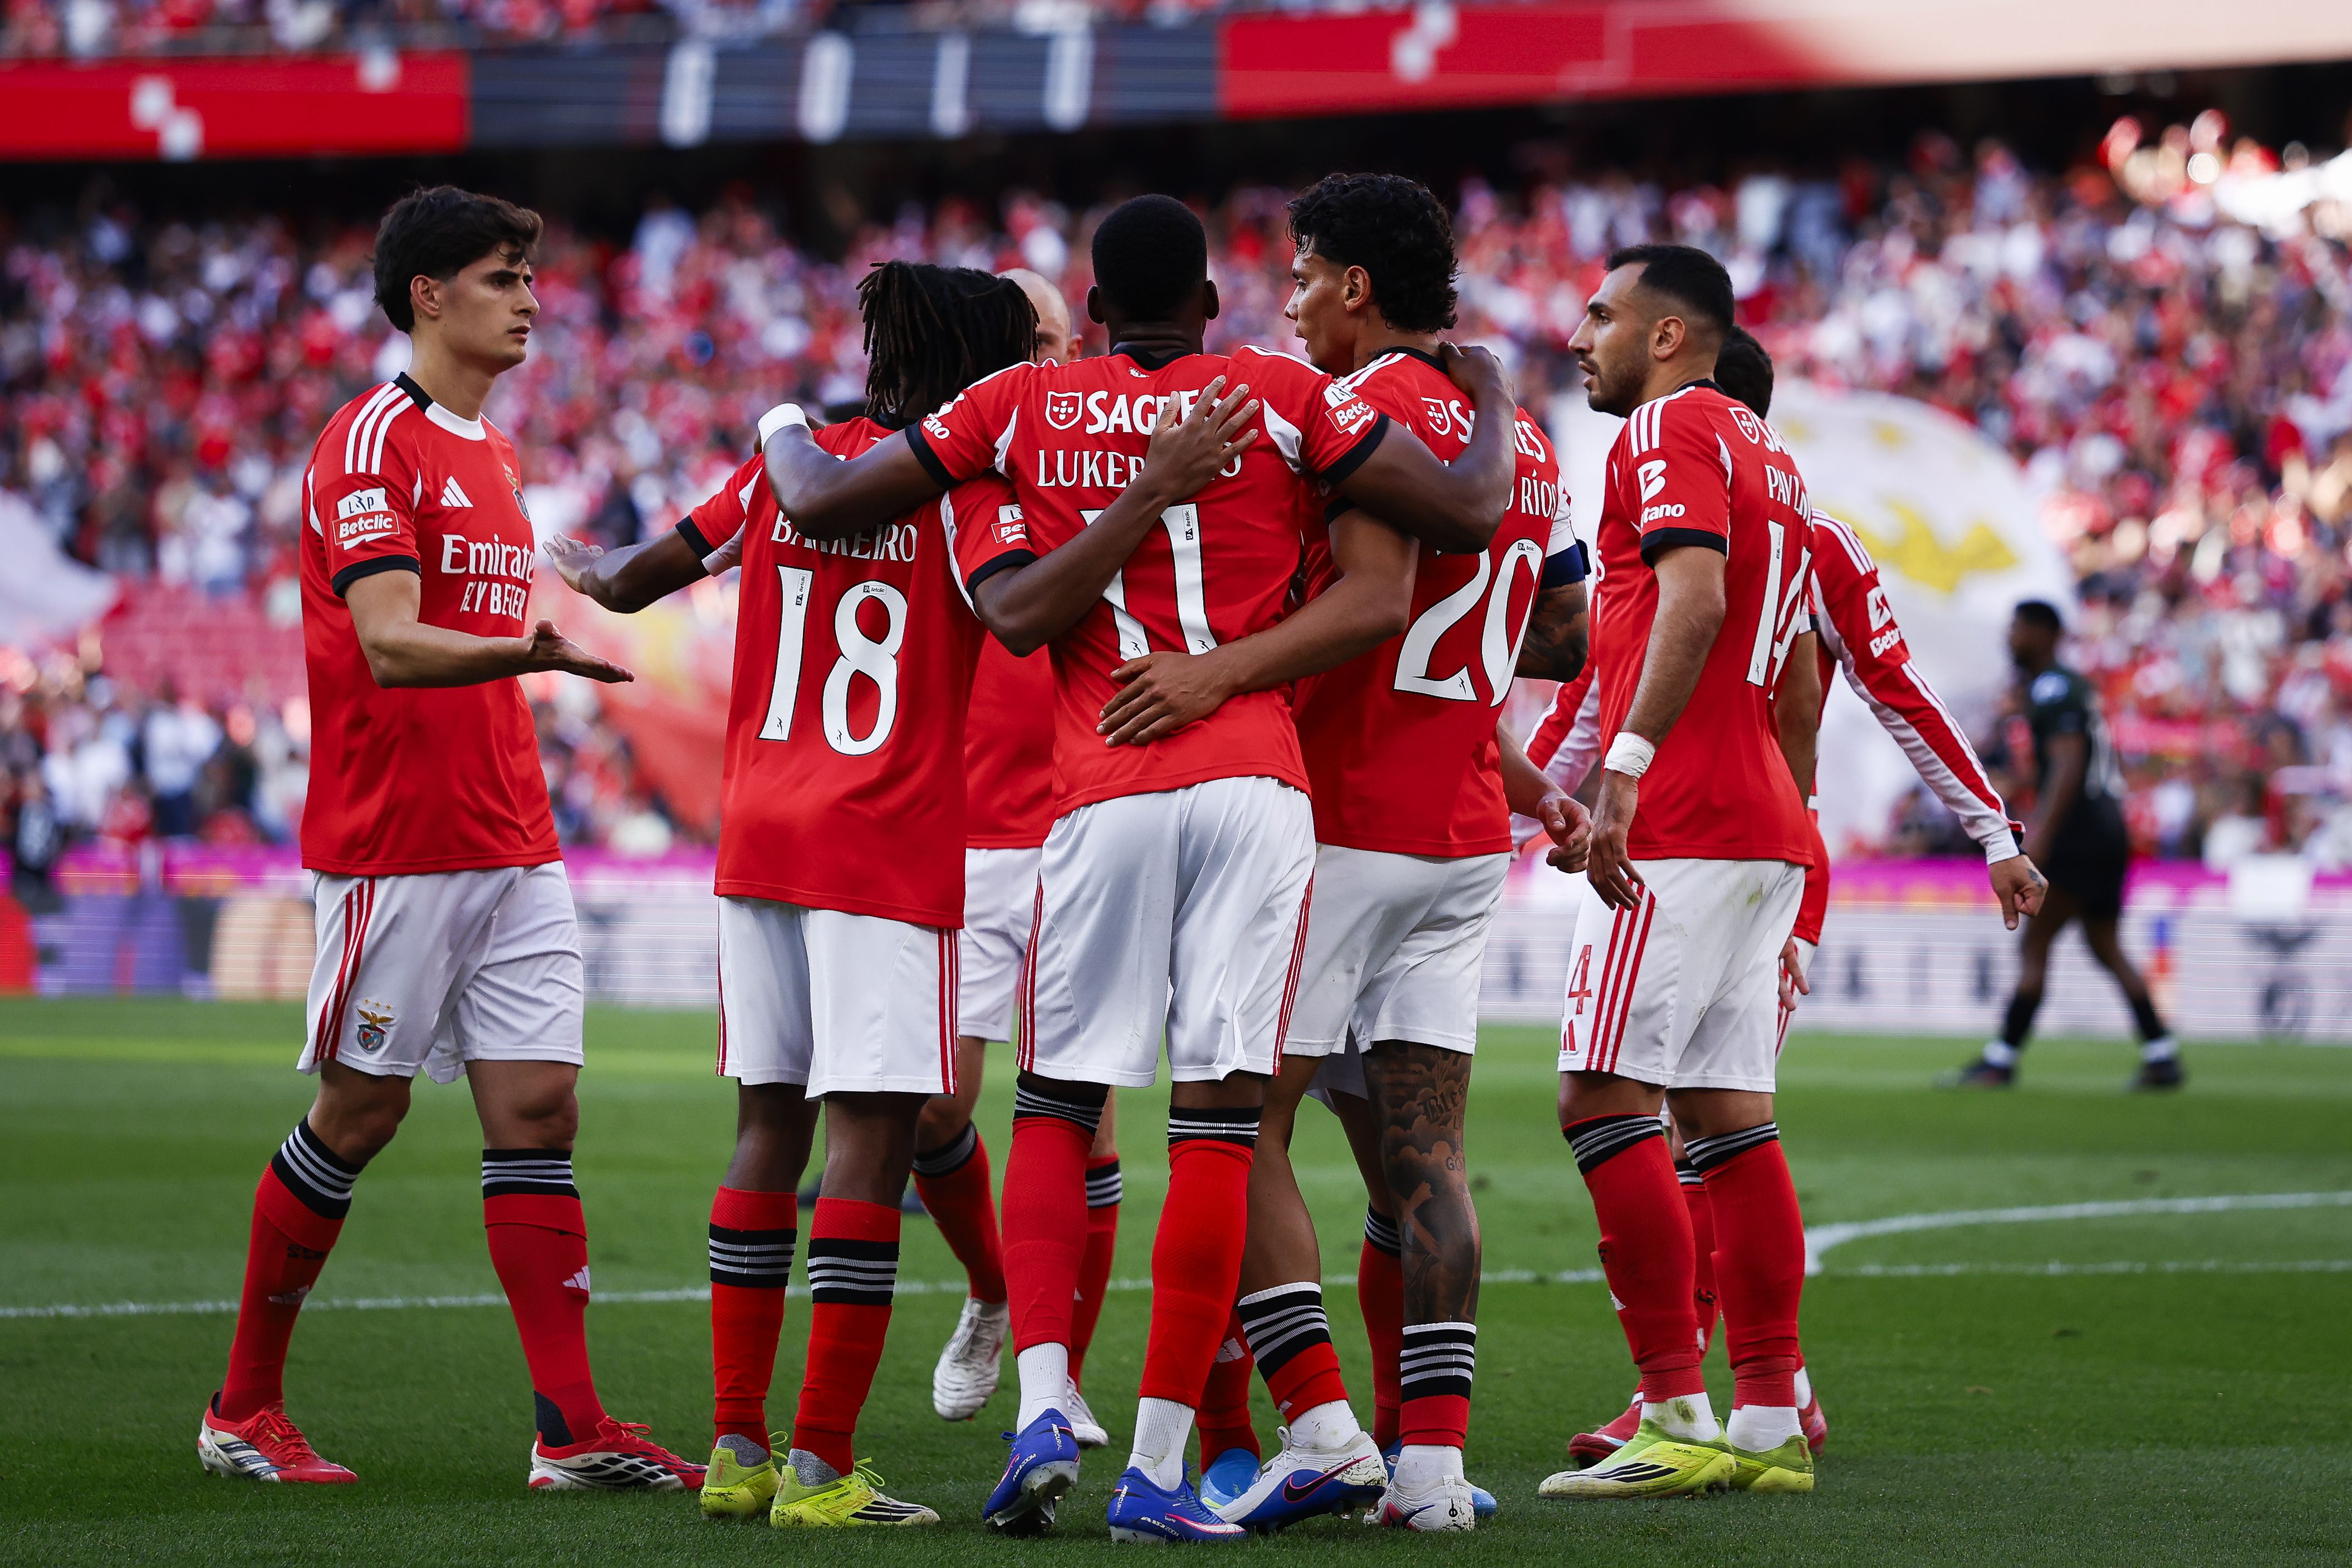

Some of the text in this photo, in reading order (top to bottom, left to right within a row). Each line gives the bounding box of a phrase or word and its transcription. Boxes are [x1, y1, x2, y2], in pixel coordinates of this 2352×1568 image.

[339, 513, 393, 538] Betclic
[1394, 538, 1543, 708] 20
[1745, 519, 1812, 700] 14
[758, 564, 909, 757] 18
[1051, 1423, 1062, 1451] MERCURIAL
[1115, 1484, 1129, 1516] MERCURIAL
